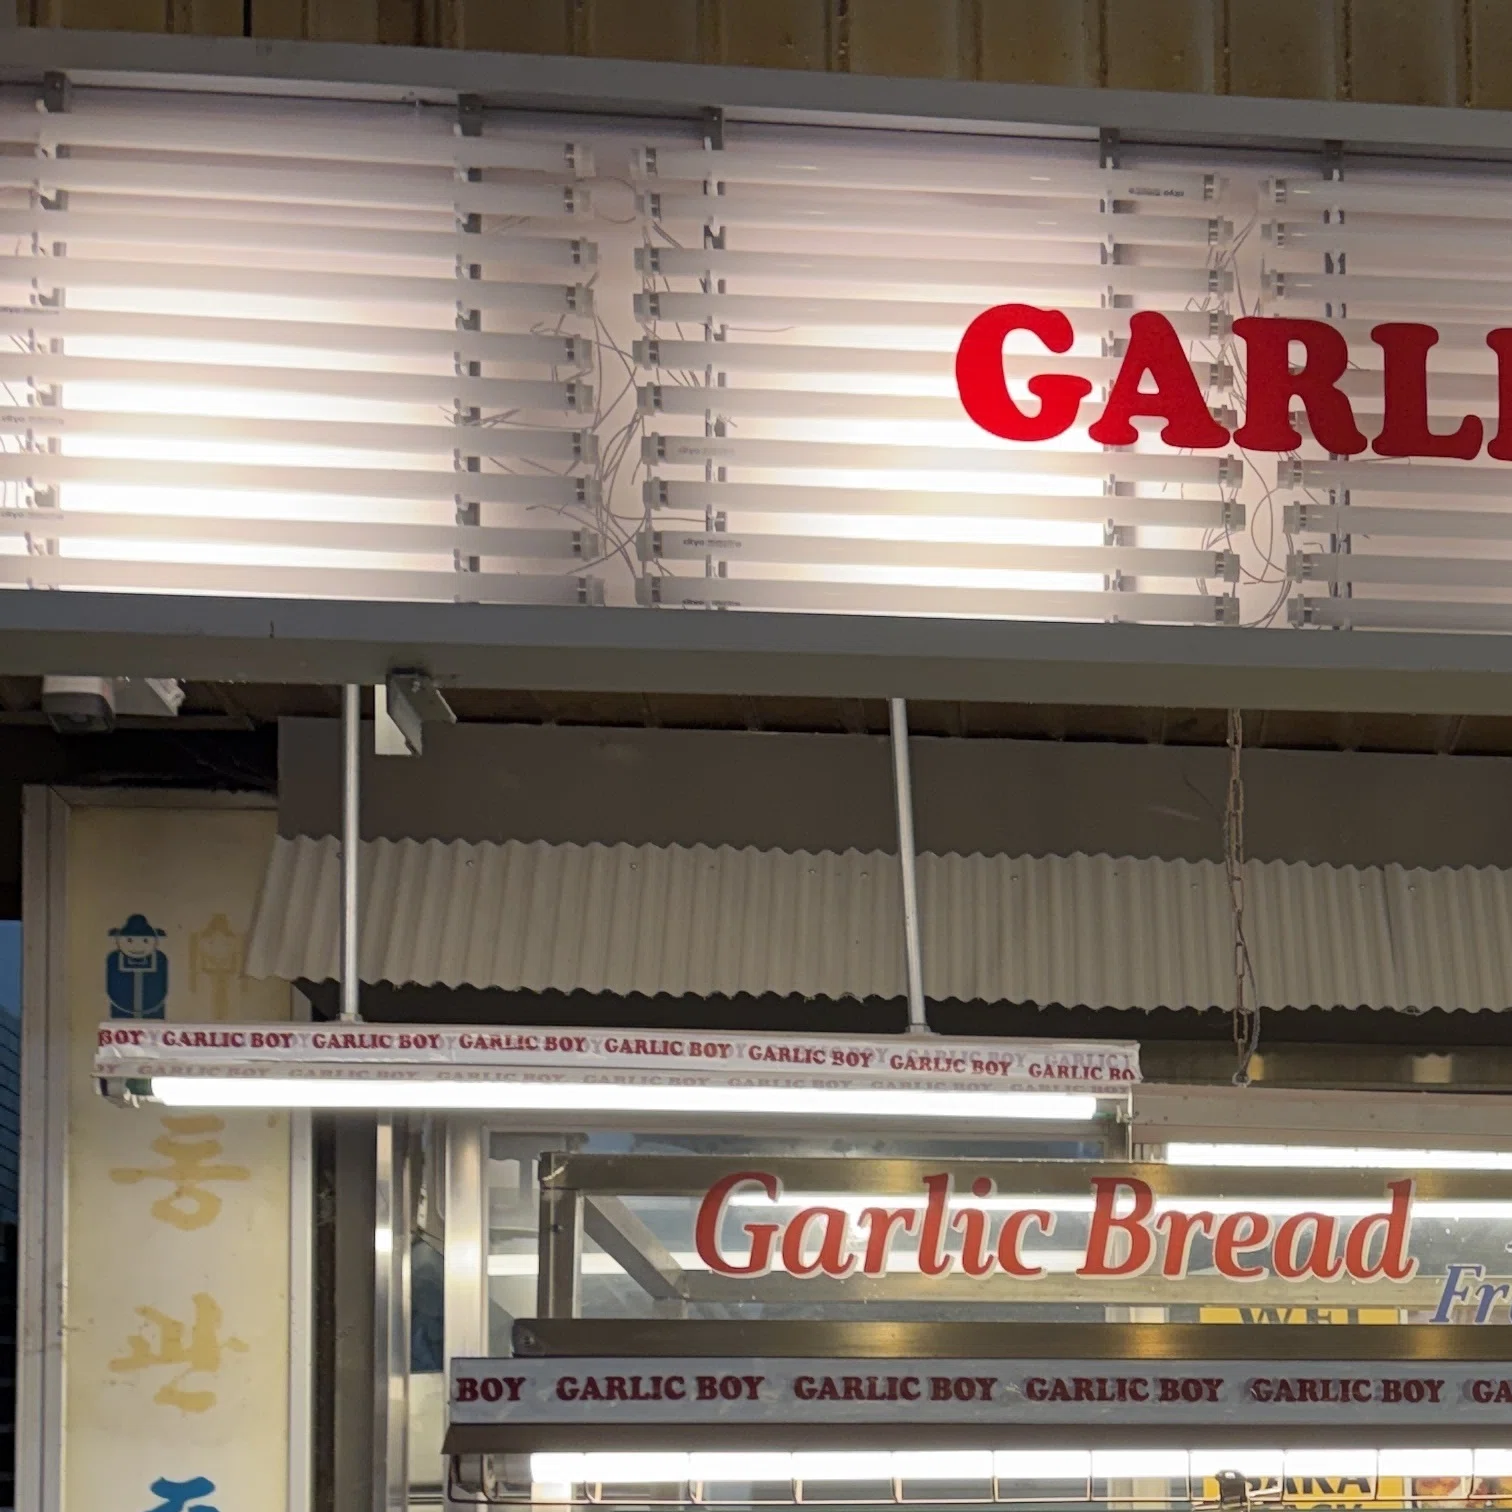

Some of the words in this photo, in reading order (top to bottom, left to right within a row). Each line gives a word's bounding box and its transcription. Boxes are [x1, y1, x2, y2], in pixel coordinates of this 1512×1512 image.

[163, 1030, 246, 1048] GARLIC
[250, 1032, 294, 1049] BOY
[312, 1032, 391, 1049] GARLIC
[398, 1033, 441, 1050] BOY
[459, 1034, 538, 1050] GARLIC
[545, 1036, 587, 1052] BOY
[604, 1038, 683, 1056] GARLIC
[690, 1041, 731, 1058] BOY
[750, 1045, 826, 1065] GARLIC
[832, 1051, 873, 1068] BOY
[890, 1055, 966, 1073] GARLIC
[972, 1060, 1012, 1076] BOY
[1028, 1063, 1103, 1081] GARLIC
[1109, 1067, 1135, 1081] BO
[695, 1171, 1054, 1279] Garlic
[1075, 1175, 1418, 1283] Bread
[456, 1377, 526, 1401] BOY
[556, 1376, 686, 1401] GARLIC
[696, 1375, 765, 1400] BOY
[793, 1376, 921, 1401] GARLIC
[930, 1376, 999, 1402] BOY
[1026, 1377, 1149, 1401] GARLIC
[1159, 1378, 1224, 1402] BOY
[1252, 1378, 1373, 1402] GARLIC
[1382, 1379, 1445, 1403] BOY
